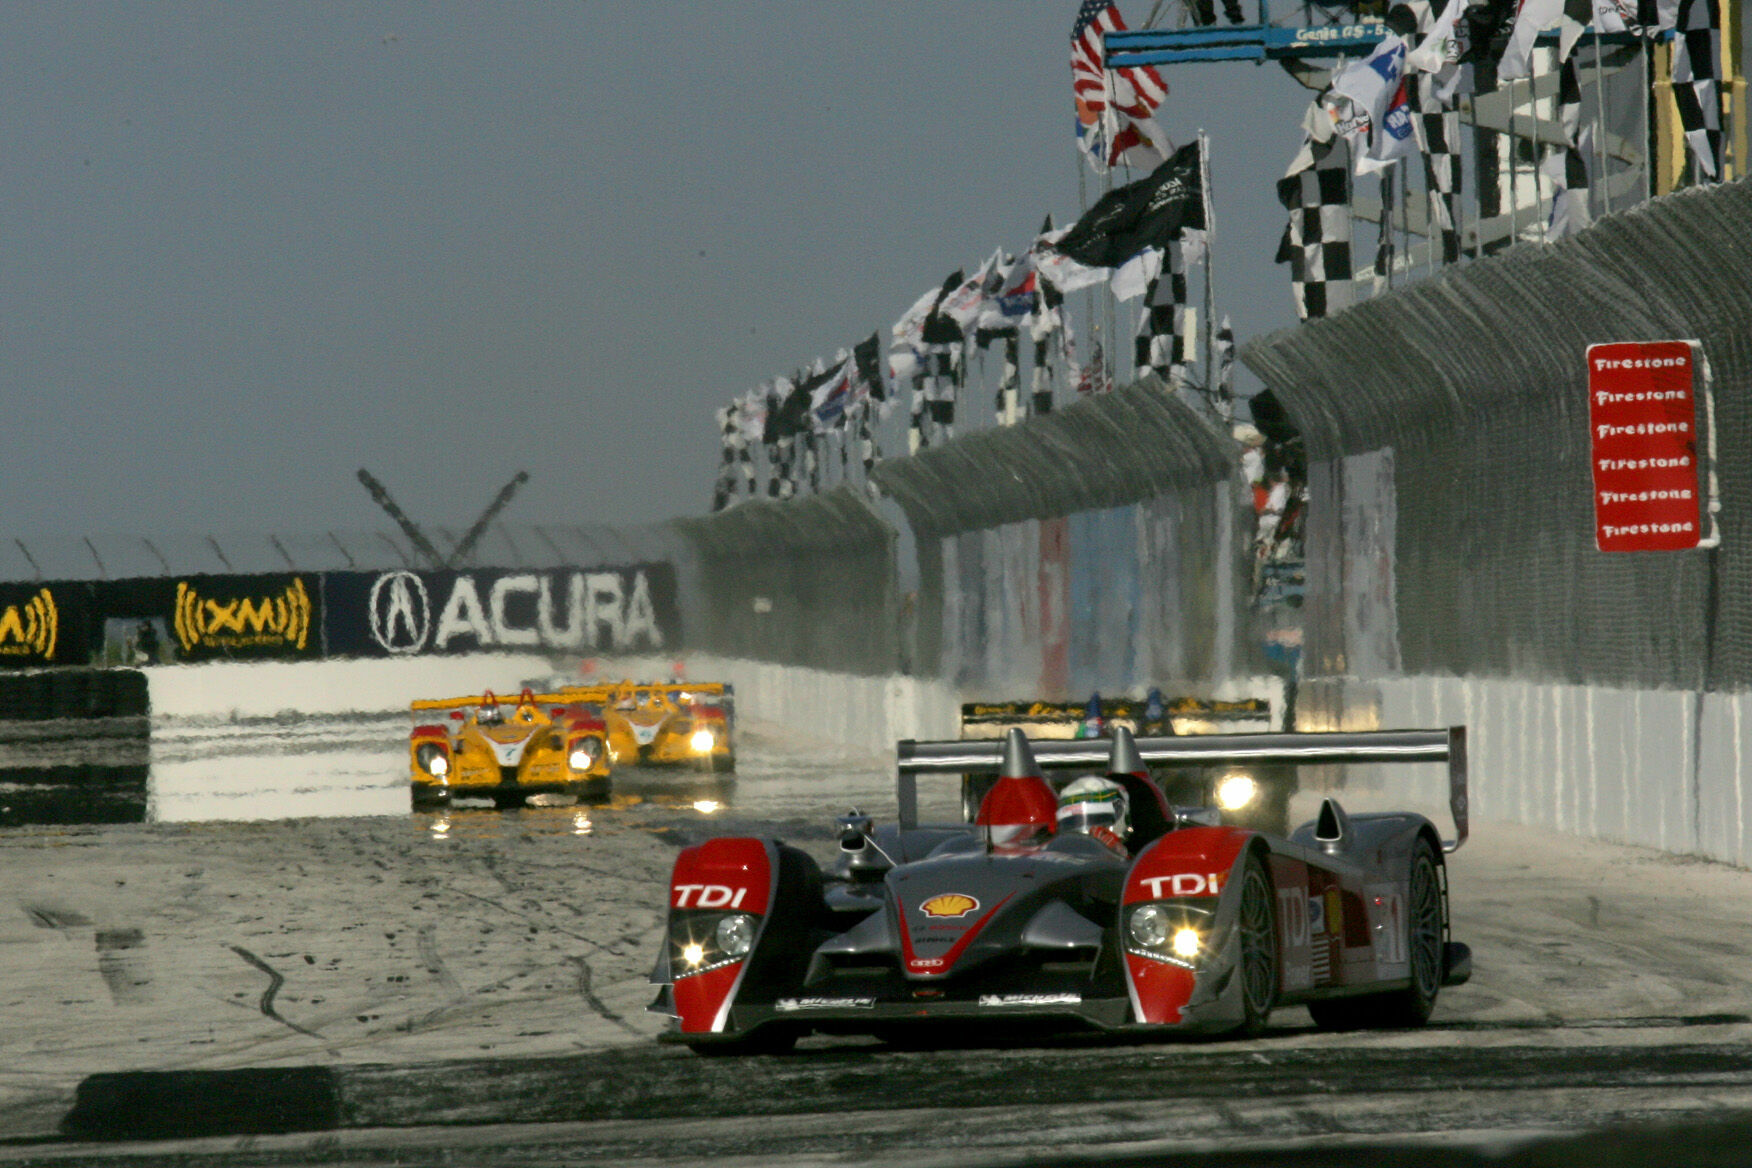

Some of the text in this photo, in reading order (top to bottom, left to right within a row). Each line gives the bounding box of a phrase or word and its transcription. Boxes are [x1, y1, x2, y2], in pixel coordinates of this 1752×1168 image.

[1595, 357, 1686, 372] Firestone
[1596, 390, 1686, 406] Firestone
[1597, 422, 1688, 439] Firestone
[1598, 456, 1690, 471] Firestone
[1600, 489, 1692, 505] Firestone
[1602, 522, 1693, 538] Firestone
[435, 570, 663, 649] ACURA
[1140, 873, 1219, 899] TDI
[673, 884, 747, 908] TDI
